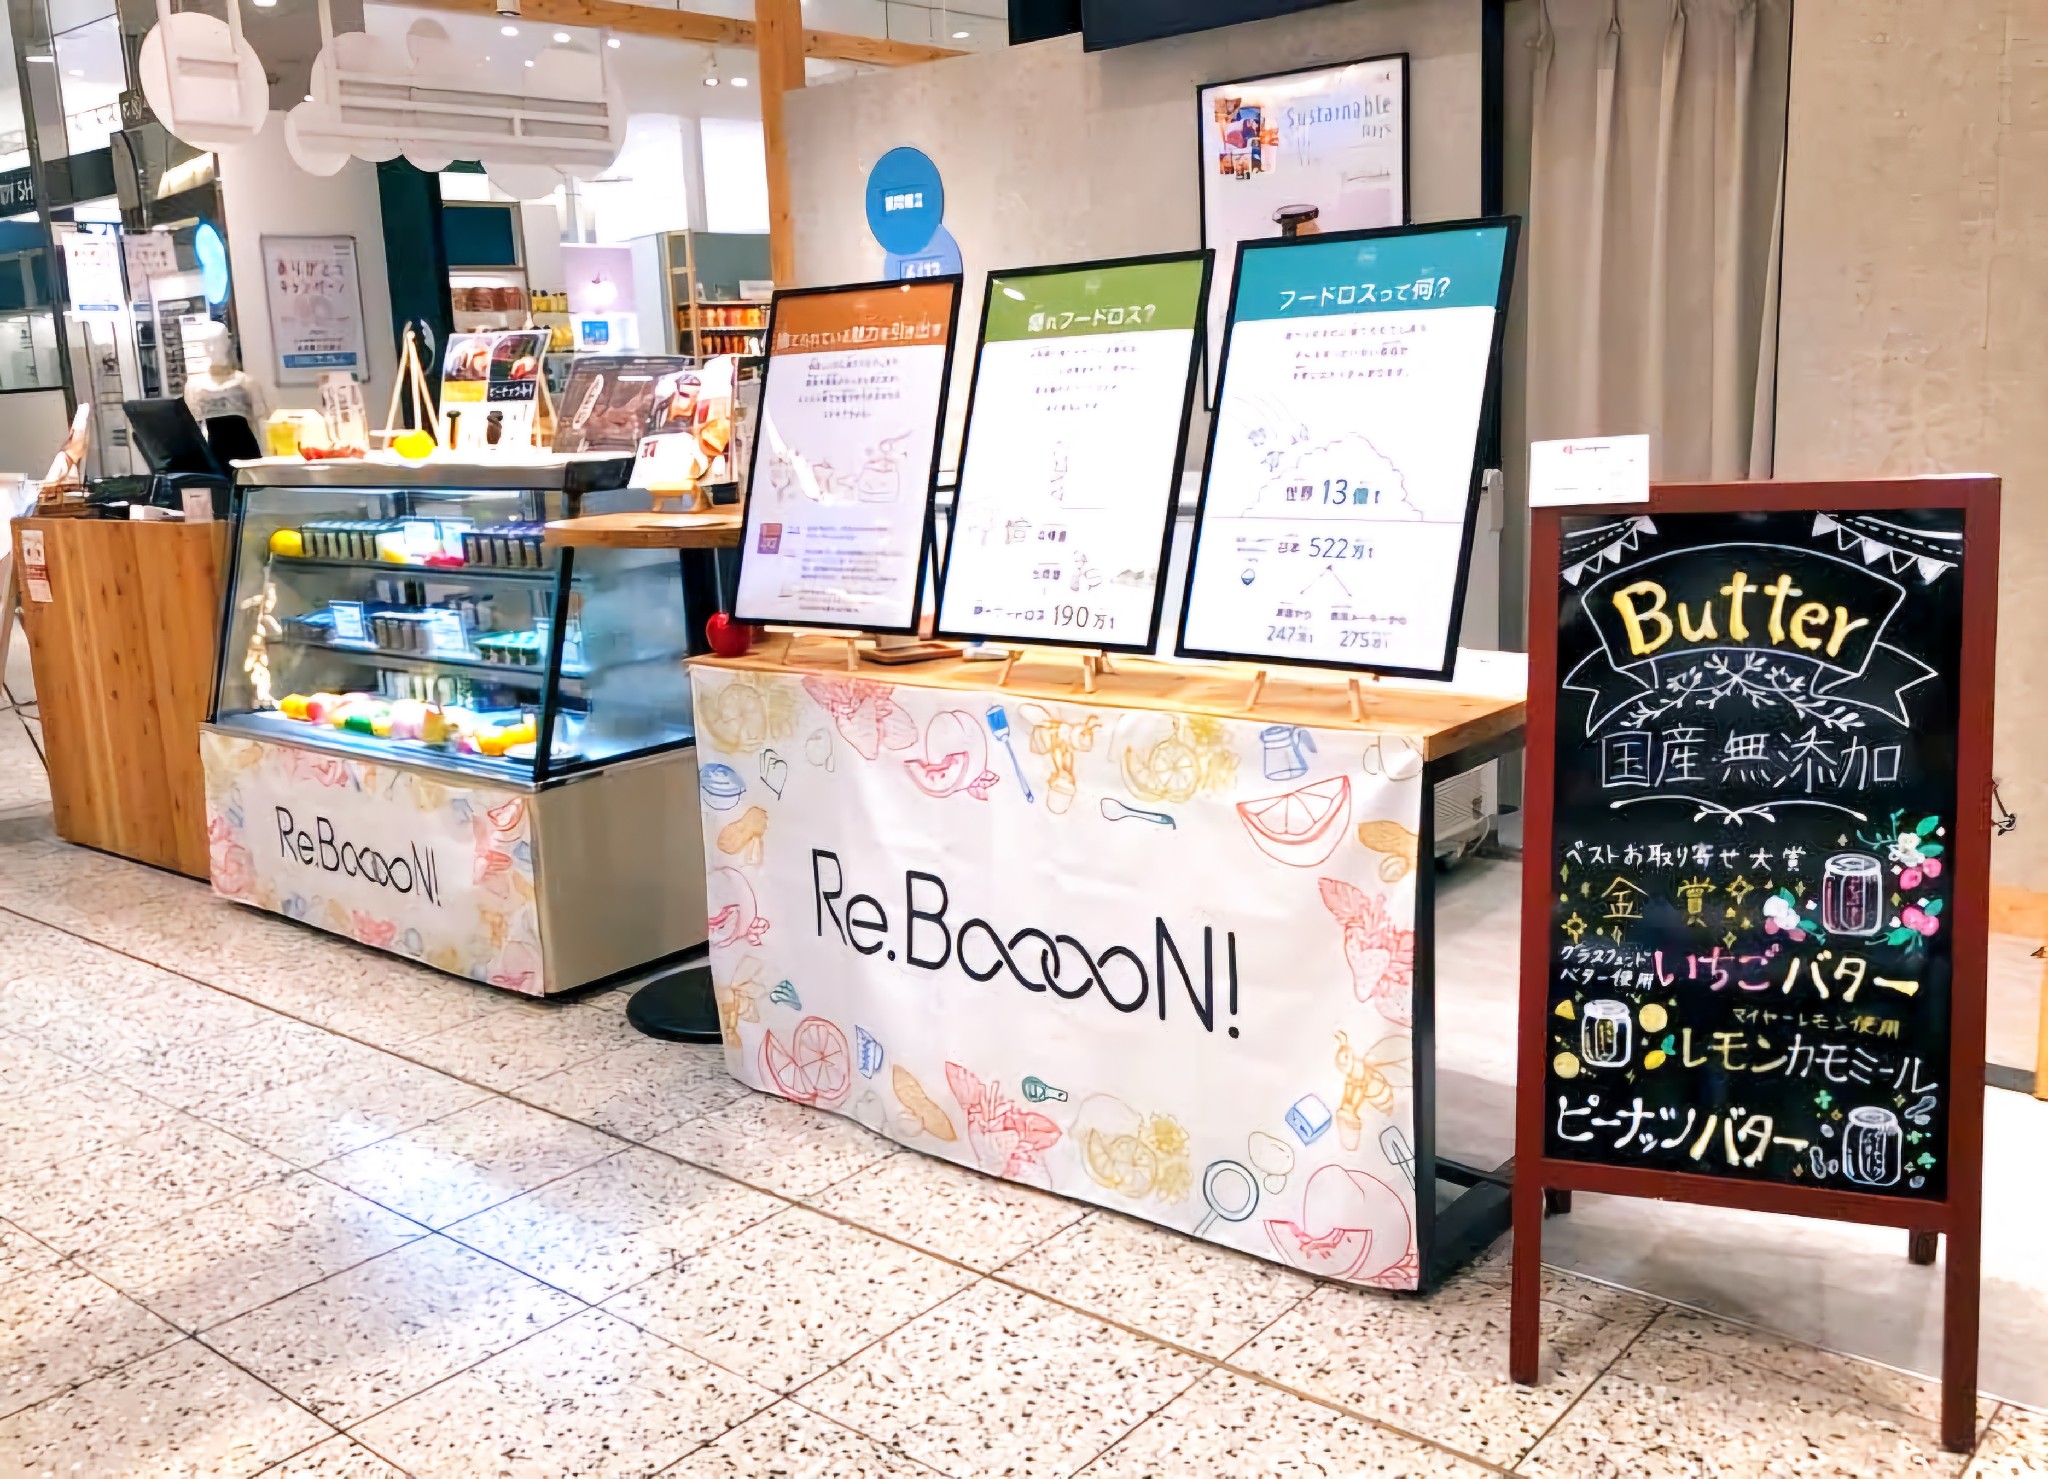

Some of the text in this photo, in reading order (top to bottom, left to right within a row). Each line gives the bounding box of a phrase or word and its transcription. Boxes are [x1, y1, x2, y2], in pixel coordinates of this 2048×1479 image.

[1612, 570, 1870, 658] Butter
[1681, 1027, 1939, 1093] レモンカモミール
[1557, 1094, 1809, 1167] ピーナッツバター
